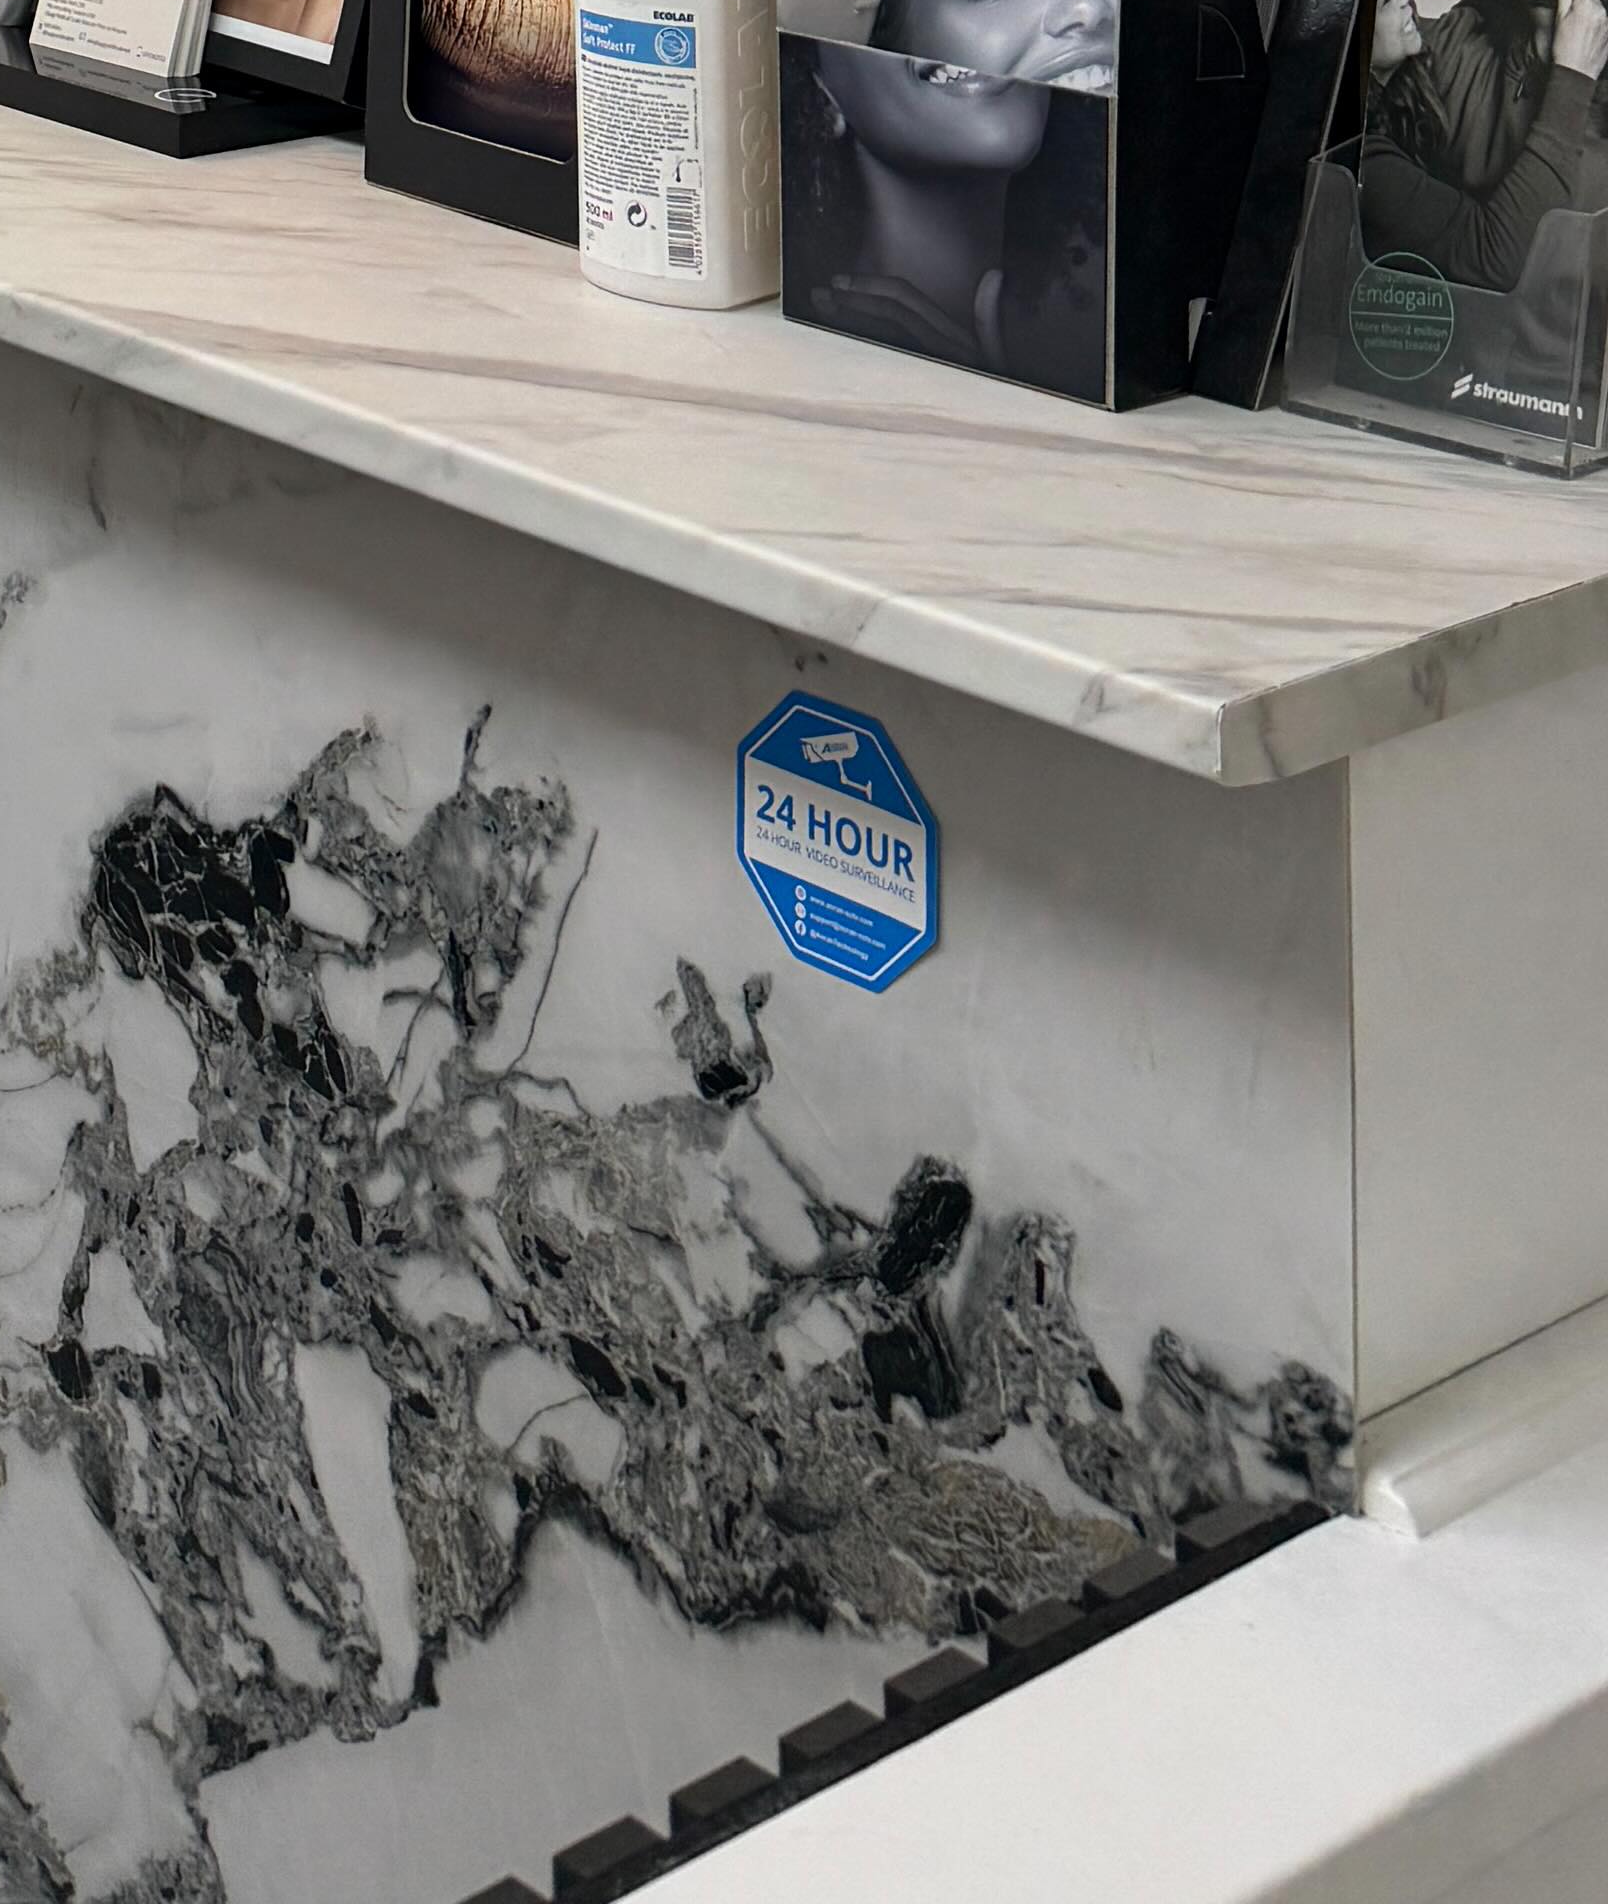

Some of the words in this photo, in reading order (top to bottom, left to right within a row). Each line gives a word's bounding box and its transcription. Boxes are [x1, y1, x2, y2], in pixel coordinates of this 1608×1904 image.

[653, 10, 695, 23] ECOLAB
[1357, 284, 1443, 311] Emdogain
[756, 784, 797, 832] 24
[808, 803, 915, 882] HOUR
[757, 825, 769, 840] 24
[772, 834, 801, 855] HOUR
[805, 845, 839, 869] VIDEO
[840, 861, 916, 903] SURVEILLANCE
